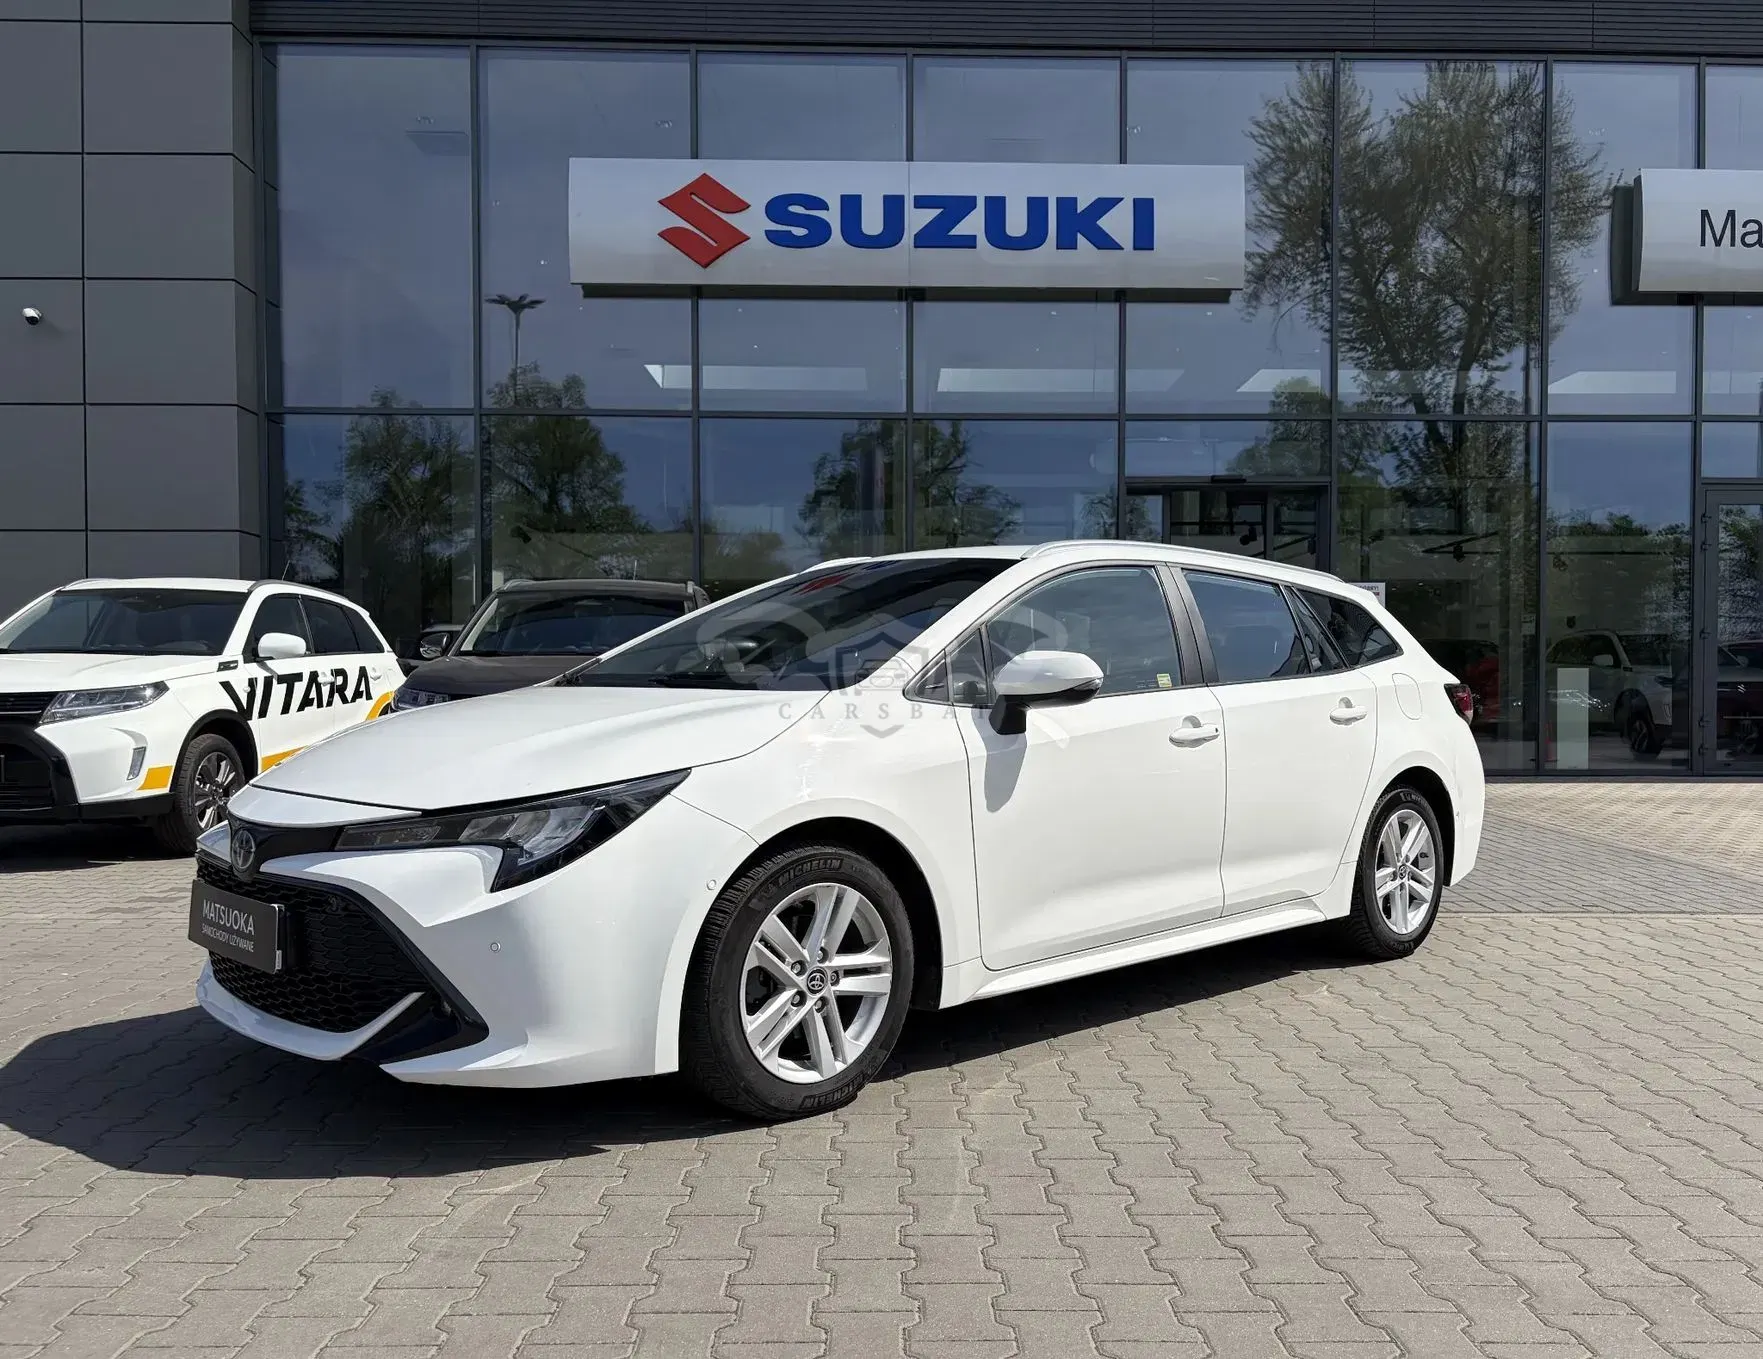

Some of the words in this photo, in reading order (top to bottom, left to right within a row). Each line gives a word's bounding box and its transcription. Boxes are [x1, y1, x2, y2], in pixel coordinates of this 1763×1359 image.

[764, 192, 1155, 251] SUZUKI
[1700, 208, 1763, 249] Ma
[219, 665, 373, 721] VITARA
[779, 859, 842, 886] MICHELIN
[201, 923, 229, 944] SAMOCHODY
[202, 899, 255, 936] MATSUOKA
